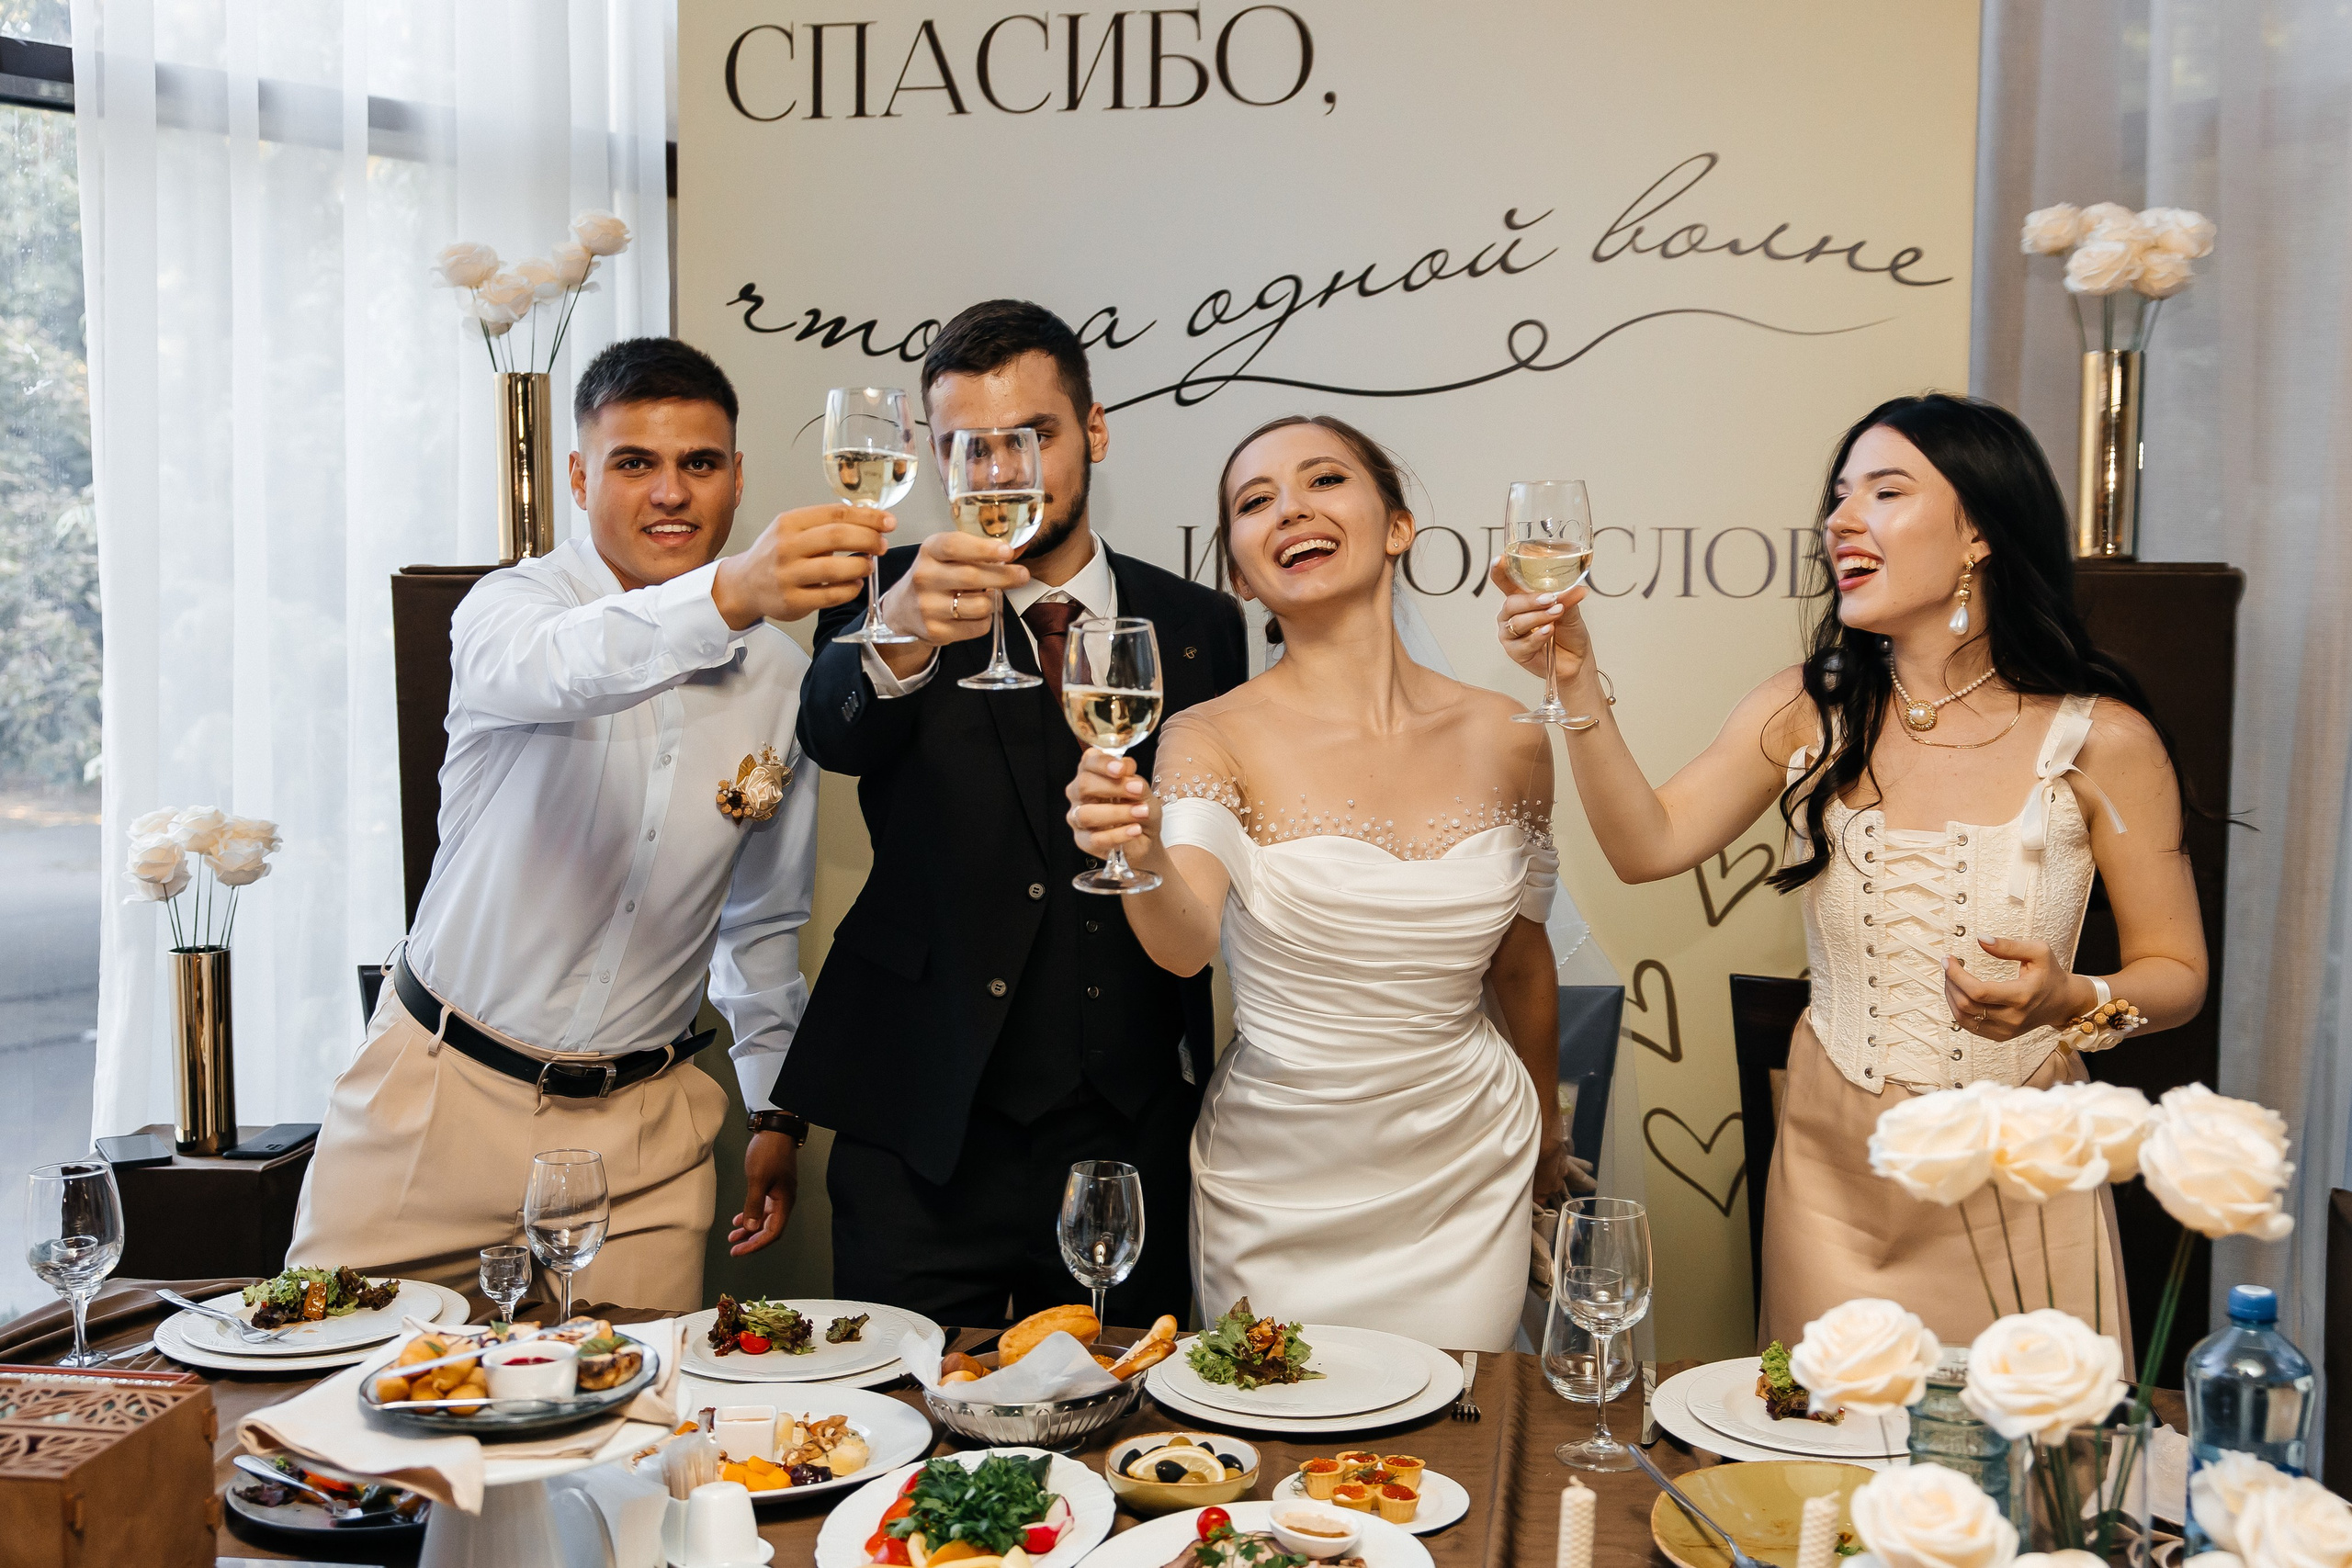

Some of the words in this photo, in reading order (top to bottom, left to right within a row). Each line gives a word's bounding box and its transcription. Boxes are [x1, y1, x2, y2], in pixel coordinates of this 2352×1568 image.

[724, 3, 1338, 122] СПАСИБО,
[726, 281, 942, 364] что
[1074, 305, 1158, 350] а
[1174, 206, 1558, 408] одной
[1591, 151, 1954, 288] волне
